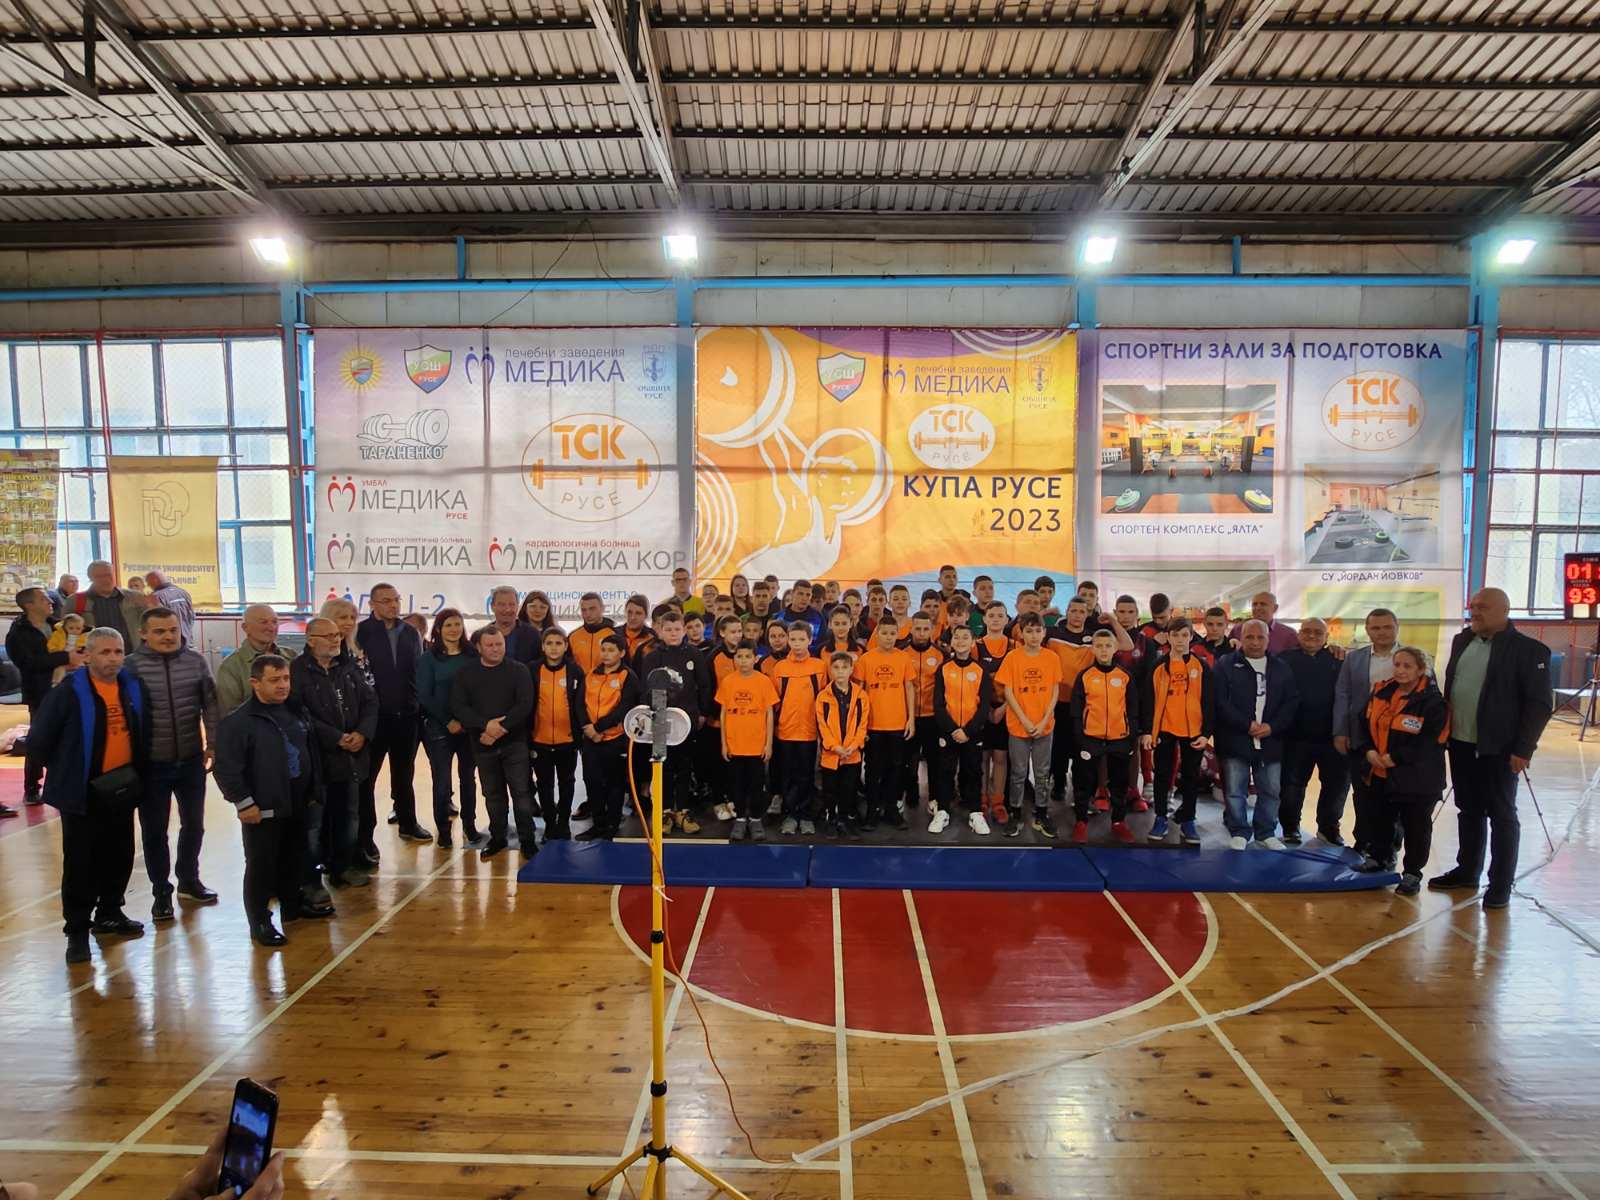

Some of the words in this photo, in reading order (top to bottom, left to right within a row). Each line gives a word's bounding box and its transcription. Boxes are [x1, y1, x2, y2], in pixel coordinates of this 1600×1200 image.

[505, 346, 556, 358] лечебни
[562, 348, 625, 359] заведения
[1104, 343, 1202, 359] СПОРТНИ
[1208, 342, 1264, 358] ЗАЛИ
[1270, 343, 1296, 358] ЗА
[1302, 342, 1442, 360] ПОДГОТОВКА
[505, 359, 625, 387] МЕДИКА
[914, 375, 1010, 396] МЕДИКА
[1346, 378, 1400, 405] ТСК
[928, 410, 975, 433] ТСК
[552, 424, 626, 460] ТСК
[1352, 428, 1398, 442] РУСЕ
[360, 445, 447, 460] ТАРАНЕНКО
[932, 452, 971, 464] РУСЕ
[903, 476, 982, 498] КУПА
[992, 476, 1062, 499] РУСЕ
[361, 489, 468, 513] МЕДИКА
[561, 491, 622, 510] РУСЕ
[990, 508, 1061, 532] 2023
[1110, 524, 1160, 534] СПОРТЕН
[1163, 524, 1225, 534] КОМПЛЕКС
[526, 540, 598, 549] кардиологична
[600, 539, 640, 549] болница
[364, 545, 472, 570] МЕДИКА
[525, 550, 628, 573] МЕДИКА
[637, 550, 686, 570] КОР
[1321, 572, 1334, 582] СУ
